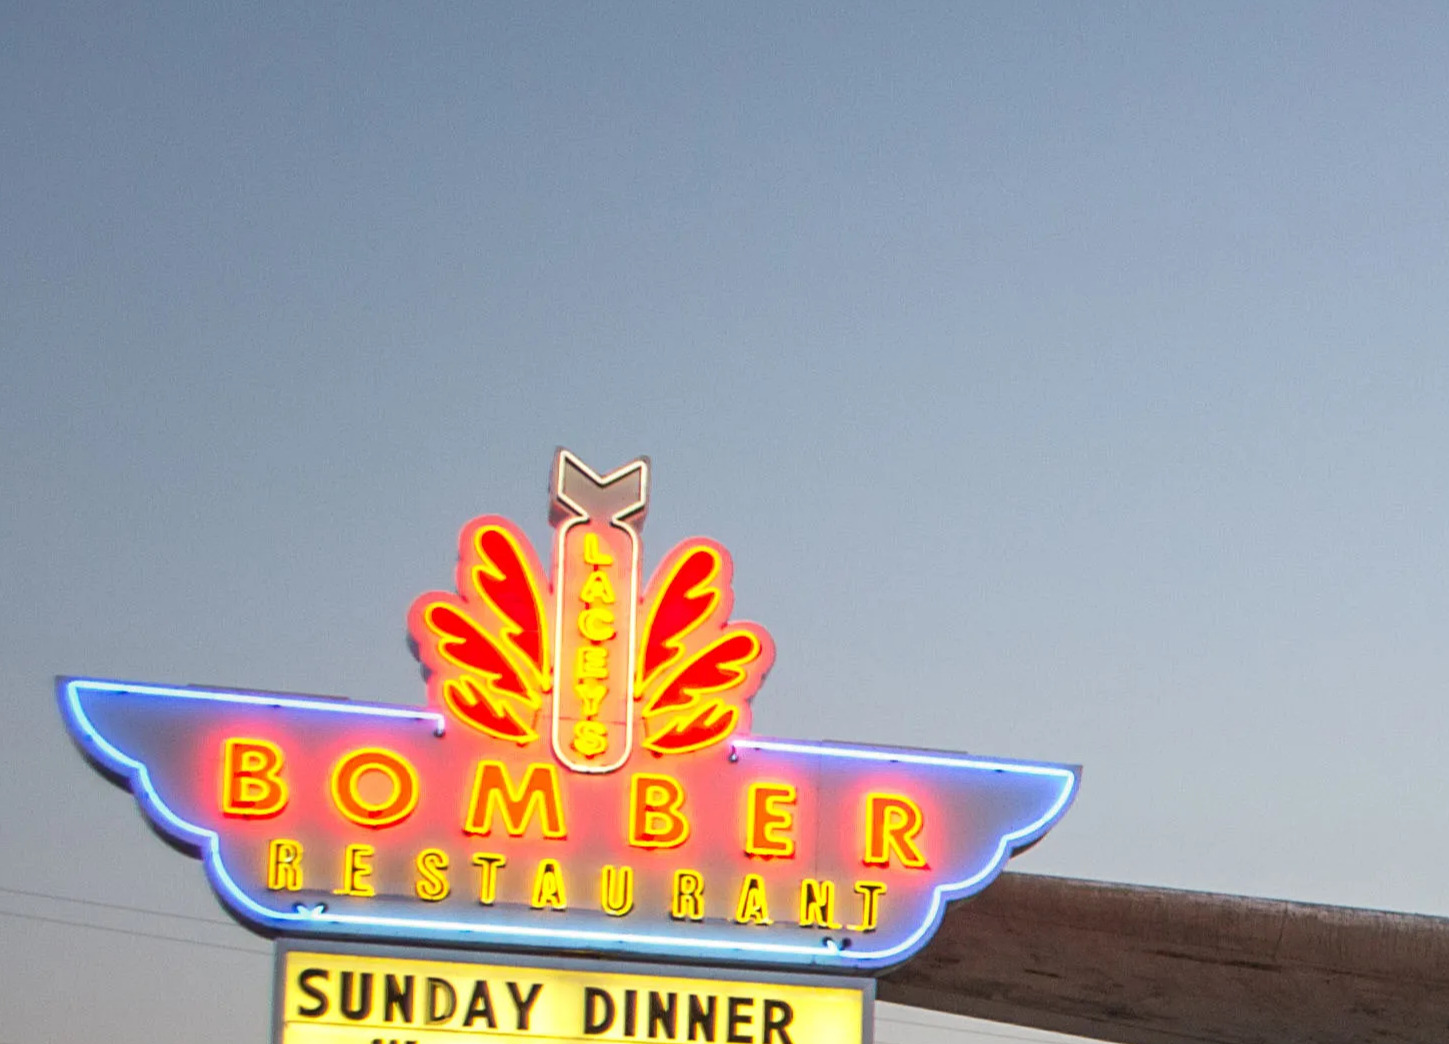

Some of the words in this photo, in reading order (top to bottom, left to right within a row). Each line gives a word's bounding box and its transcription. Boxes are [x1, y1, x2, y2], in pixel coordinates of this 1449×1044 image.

[222, 737, 931, 870] BOMBER
[267, 838, 888, 932] RESTAURANT
[296, 966, 543, 1031] SUNDAY
